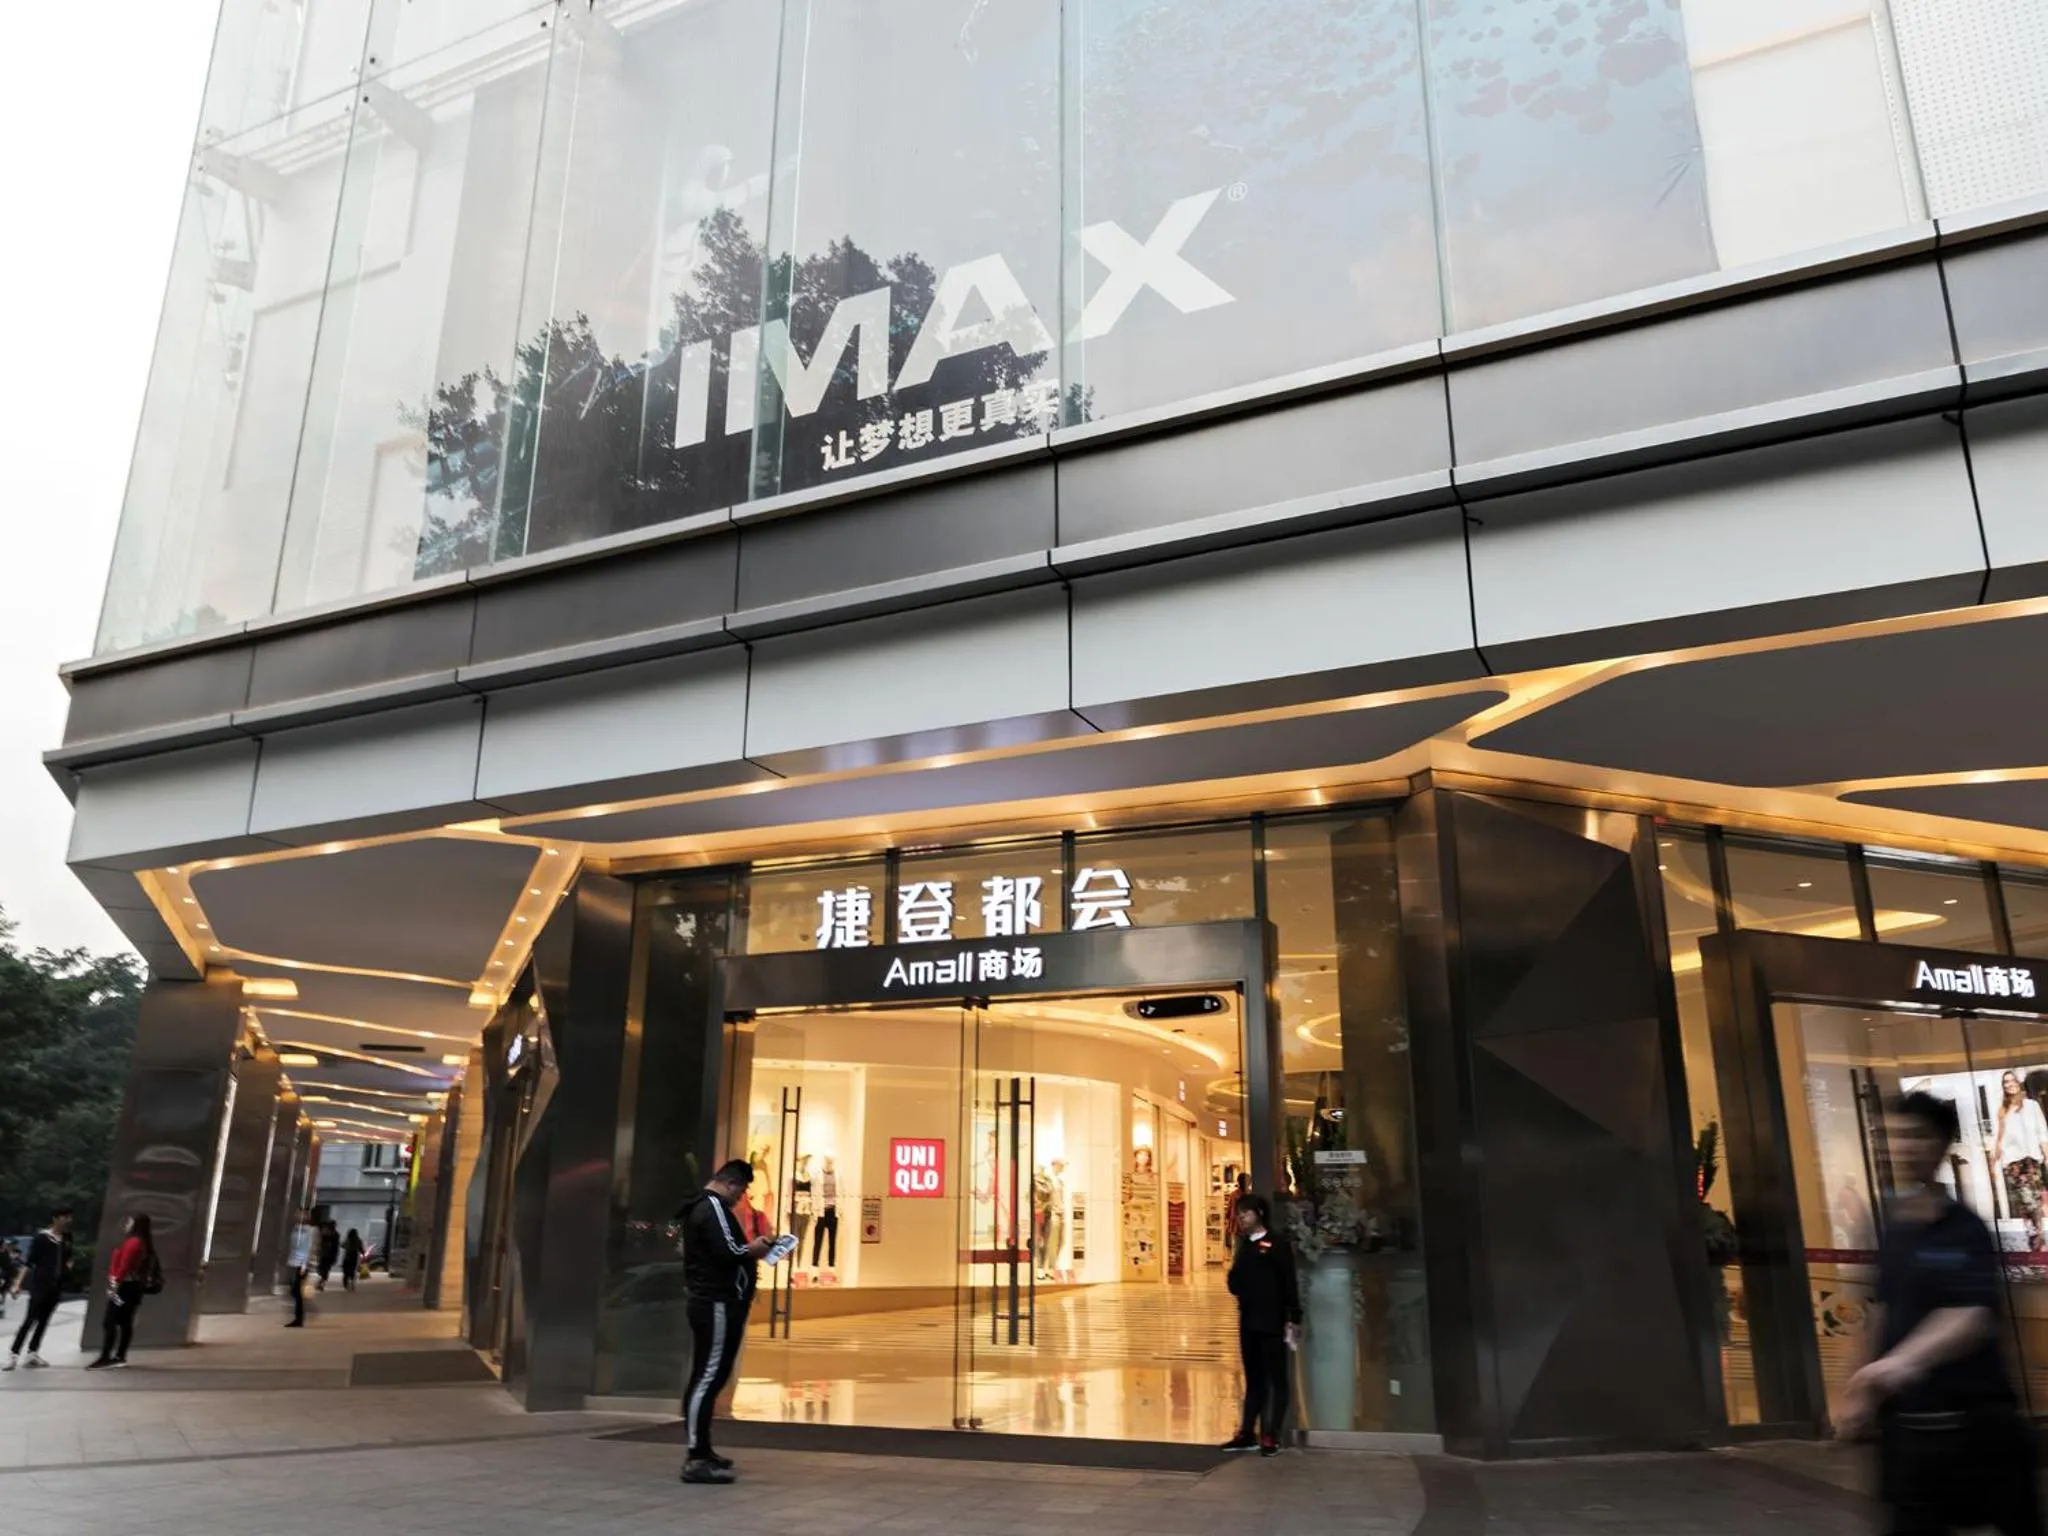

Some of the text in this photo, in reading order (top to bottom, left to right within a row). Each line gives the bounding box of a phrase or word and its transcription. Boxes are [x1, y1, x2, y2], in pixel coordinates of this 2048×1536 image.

[820, 378, 1061, 471] 让梦想更真实
[816, 867, 1134, 950] 捷登都会
[895, 1168, 939, 1194] QLO
[896, 1144, 936, 1168] UNI
